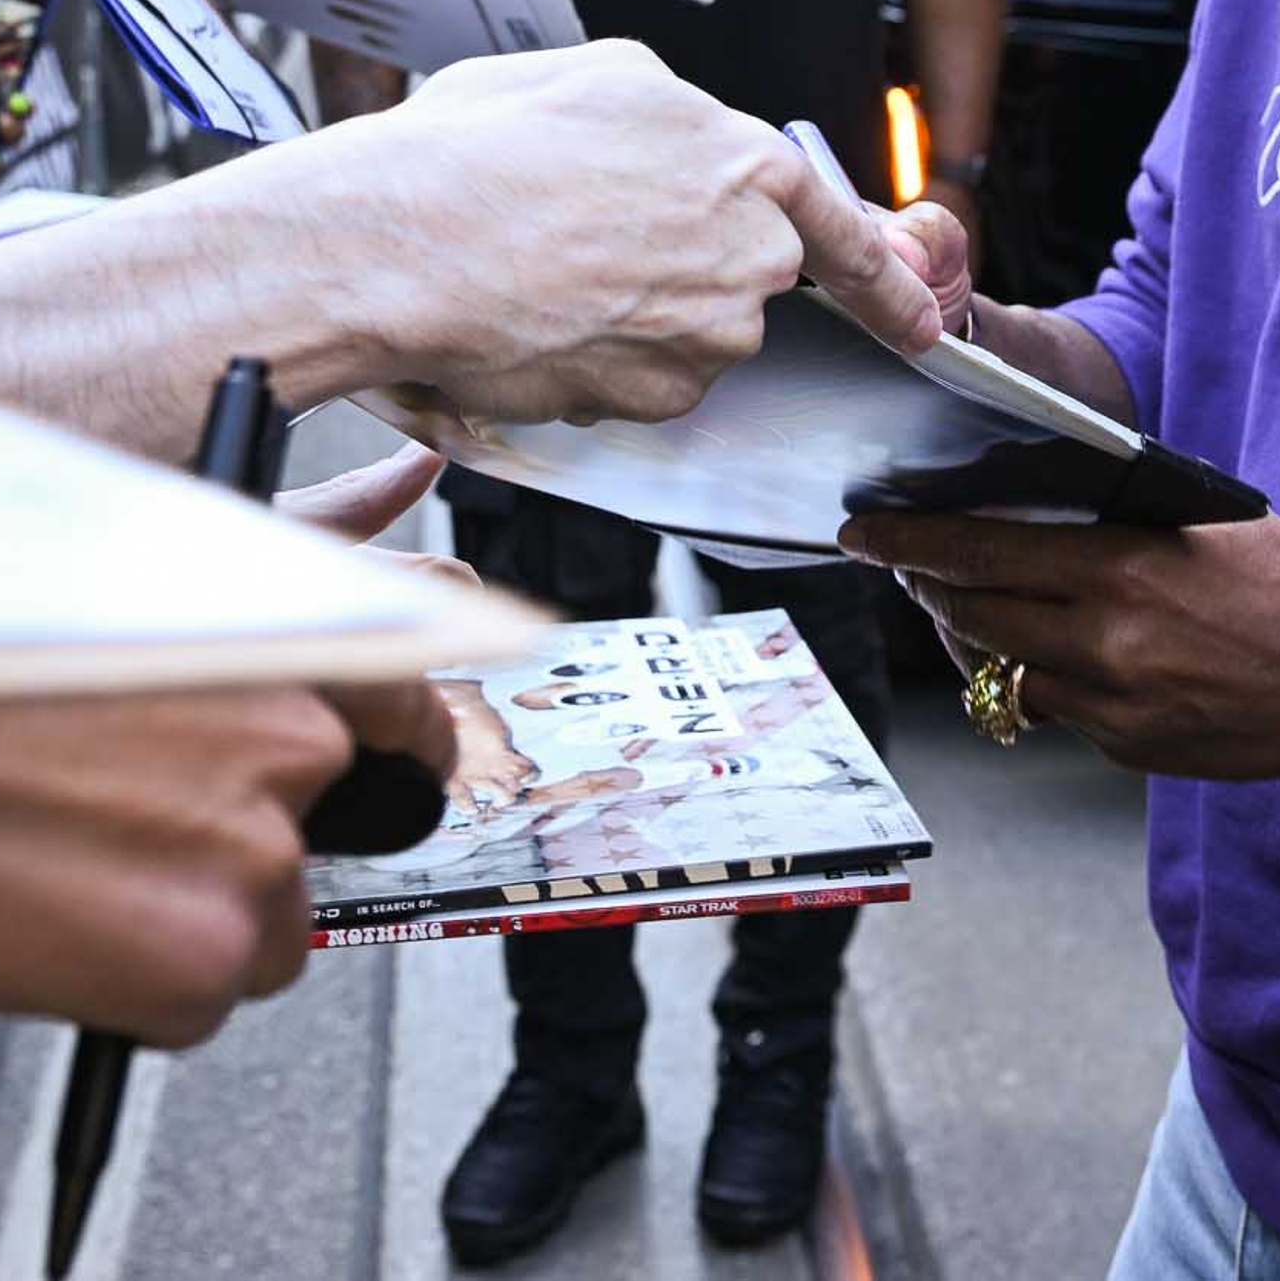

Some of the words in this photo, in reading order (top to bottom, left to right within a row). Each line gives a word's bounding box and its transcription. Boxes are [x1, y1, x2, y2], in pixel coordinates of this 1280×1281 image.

[372, 901, 416, 914] SEARCH
[659, 902, 699, 917] STAR
[700, 900, 739, 913] TRAK
[326, 922, 445, 947] NOTHING
